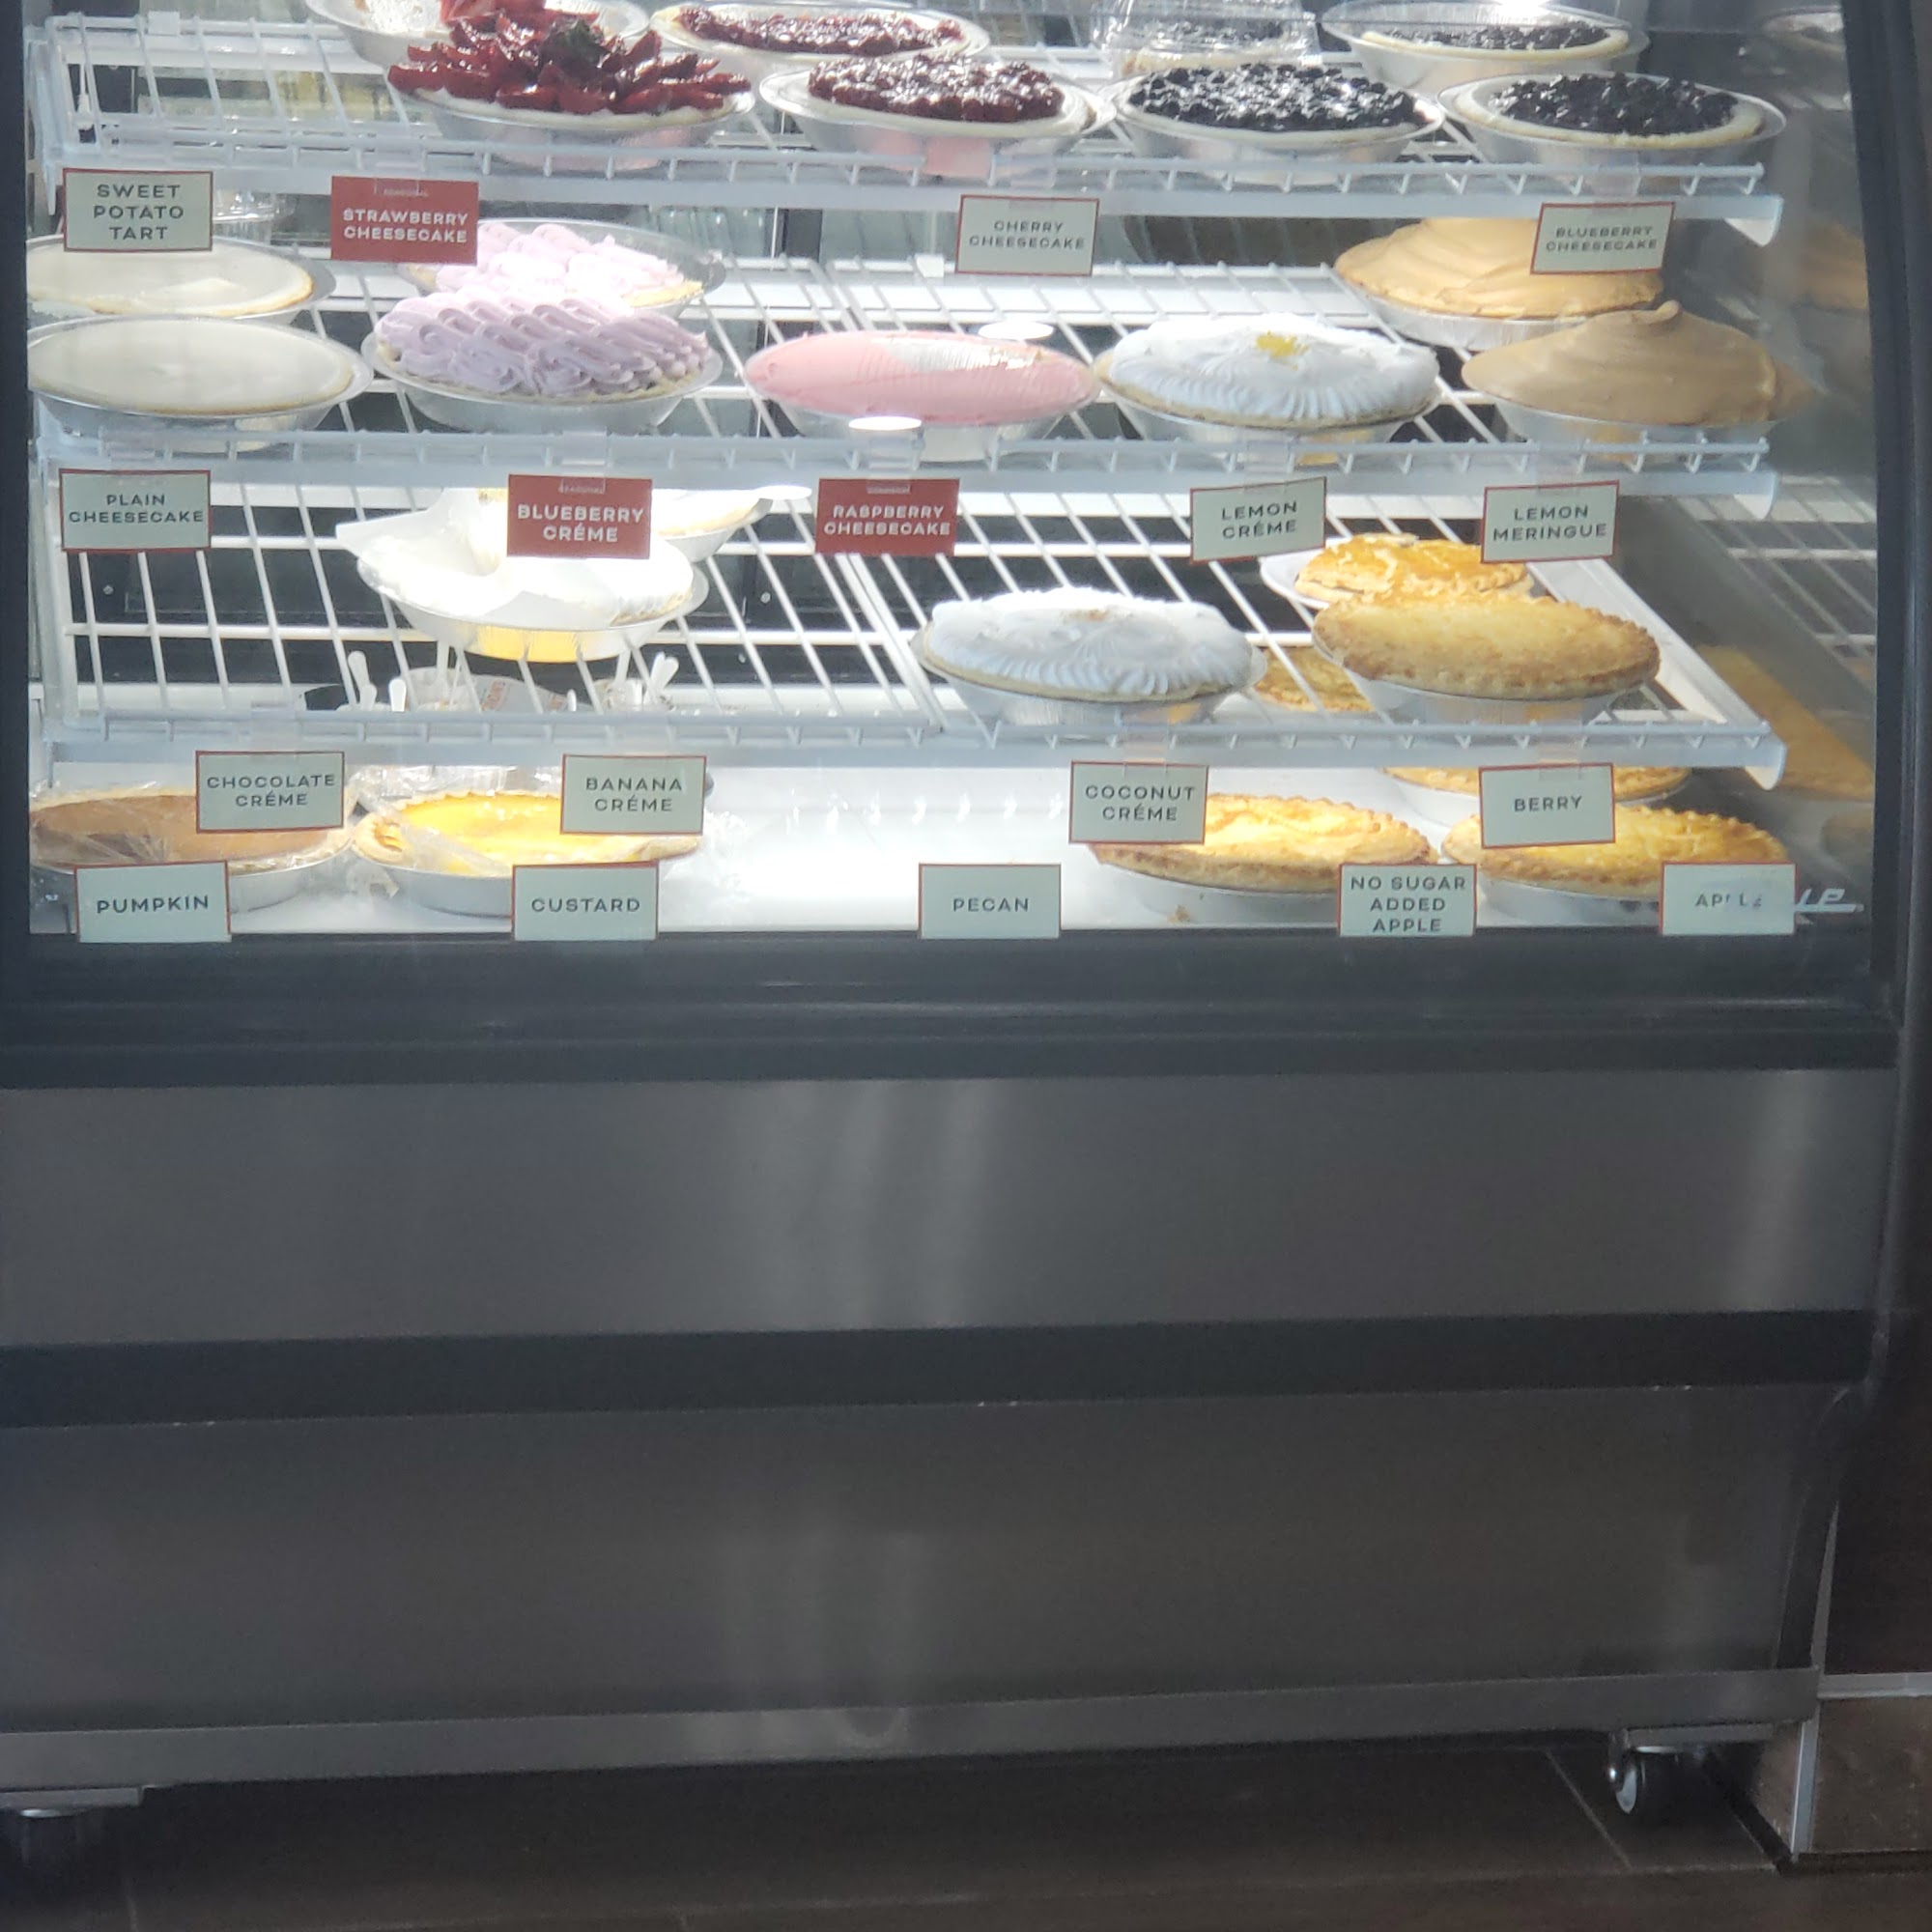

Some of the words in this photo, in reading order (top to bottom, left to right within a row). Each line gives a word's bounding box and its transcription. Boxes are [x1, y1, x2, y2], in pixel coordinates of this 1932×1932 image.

[98, 184, 181, 199] SWEET
[93, 205, 185, 220] POTATO
[343, 208, 469, 226] STRAWBERRY
[108, 226, 169, 241] TART
[994, 220, 1064, 232] CHERRY
[1555, 225, 1654, 239] BLUEBERRY
[343, 226, 469, 243] CHEESECAKE
[969, 237, 1086, 250] CHEESECAKE
[1546, 240, 1658, 252] CHEESECAKE
[105, 494, 166, 507] PLAIN
[69, 510, 204, 524] CHEESECAKE
[517, 503, 644, 523] BLUEBERRY
[833, 504, 945, 519] RASPBERRY
[1221, 500, 1297, 522] LEMON
[1514, 504, 1589, 522] LEMON
[823, 521, 951, 536] CHEESECAKE
[1492, 523, 1607, 542] MERINGUE
[207, 774, 335, 789] CHOCOLATE
[585, 777, 683, 792] BANANA
[1085, 784, 1196, 801] COCONUT
[1514, 795, 1583, 812] BERRY
[1350, 876, 1382, 891] NO
[1390, 876, 1466, 891] SUGAR
[96, 895, 209, 914] PUMPKIN
[531, 897, 640, 913] CUSTARD
[952, 897, 1029, 913] PECAN
[1369, 897, 1446, 912] ADDED
[1371, 918, 1442, 933] APPLE
